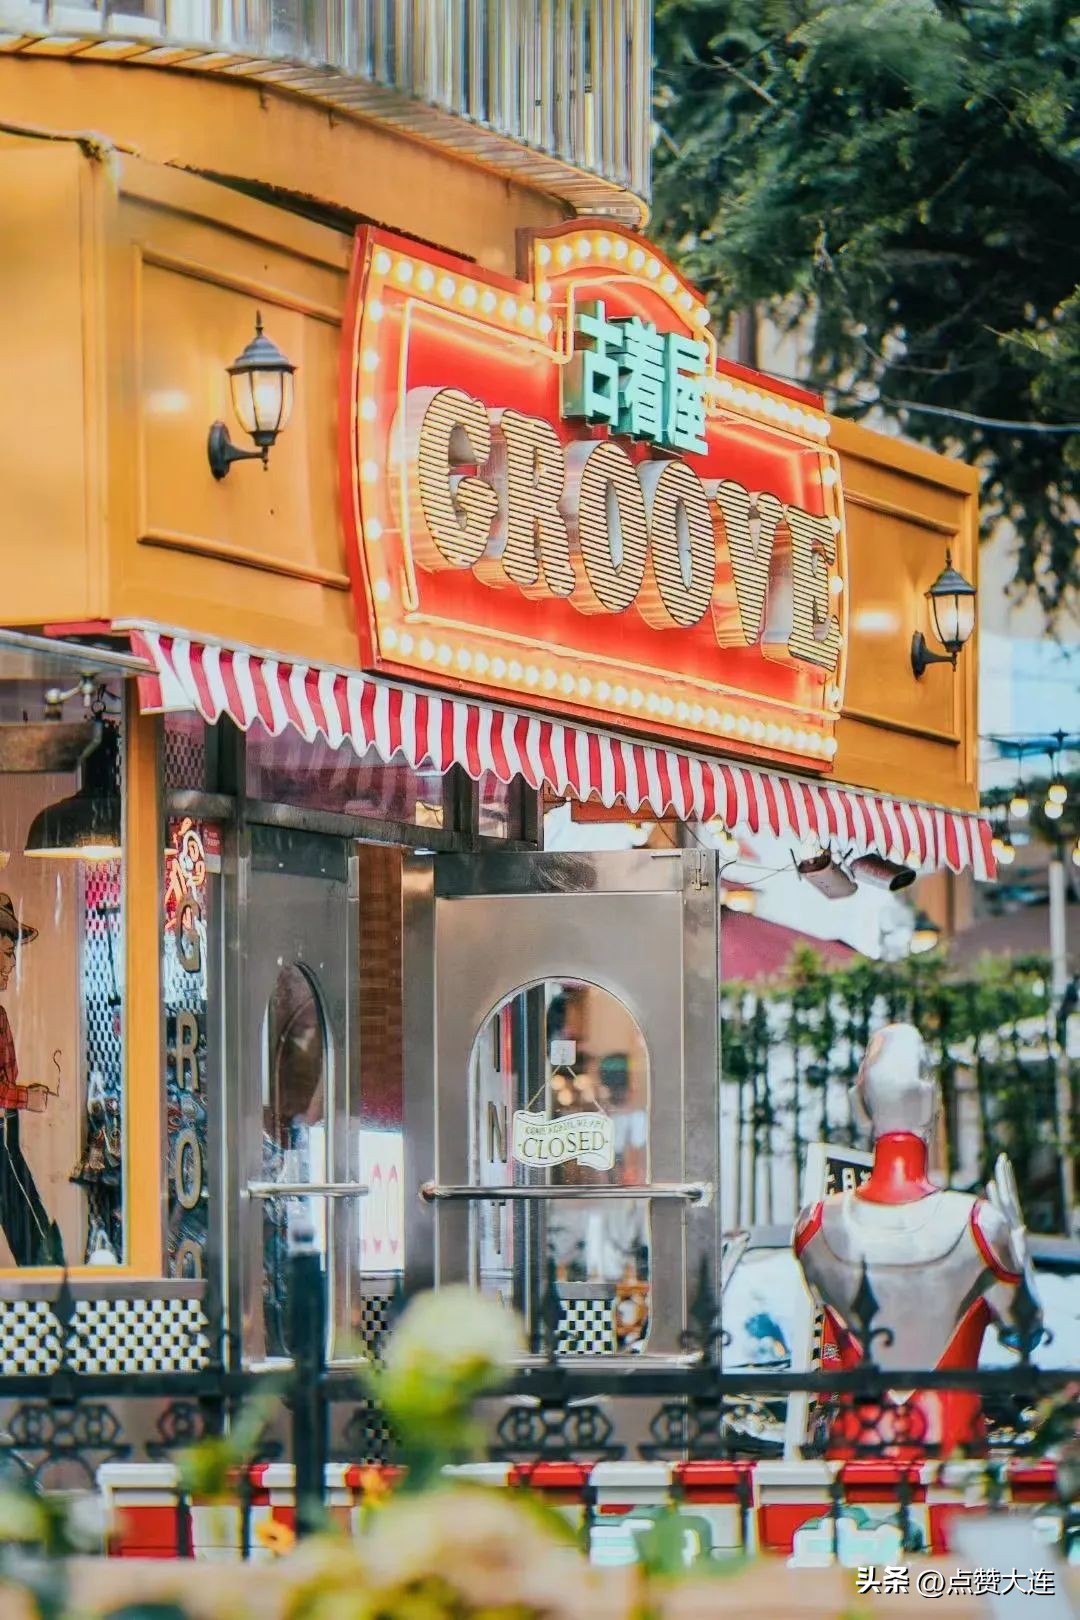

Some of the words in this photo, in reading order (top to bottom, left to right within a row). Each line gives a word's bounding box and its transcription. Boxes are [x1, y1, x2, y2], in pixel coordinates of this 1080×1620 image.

[578, 299, 709, 456] 古着屋
[418, 386, 842, 673] GROOVE
[522, 1130, 605, 1160] CLOSED
